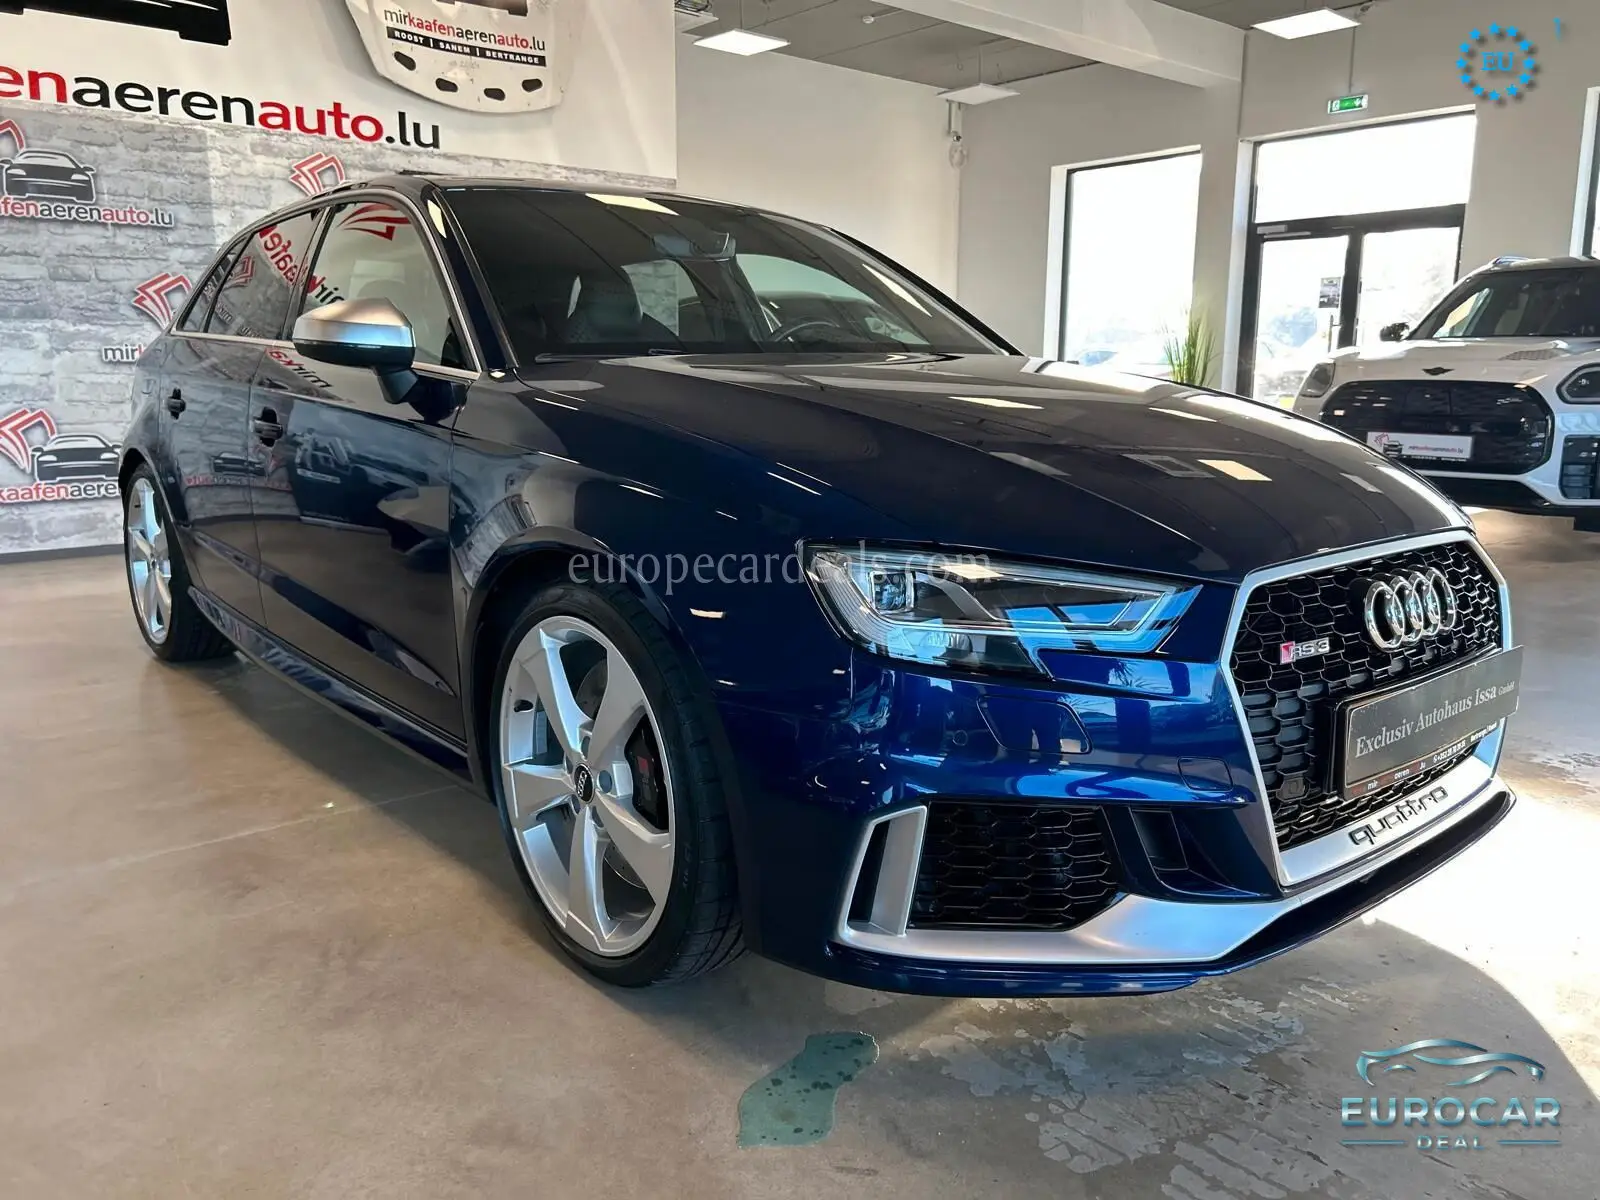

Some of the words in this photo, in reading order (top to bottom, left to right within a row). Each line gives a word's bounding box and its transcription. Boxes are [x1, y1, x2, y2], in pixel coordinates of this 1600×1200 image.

[384, 9, 545, 51] mirkaafenaerenauto.lu
[394, 30, 424, 44] ROOST
[439, 42, 470, 54] SANEM
[485, 50, 540, 64] BERTRANGE
[0, 196, 173, 225] fenaerenauto.lu
[0, 482, 120, 500] aafenaere
[1355, 719, 1414, 758] Exclusiv
[1414, 700, 1472, 733] Autohaus
[1474, 685, 1497, 706] Issa
[1348, 786, 1448, 845] quattro
